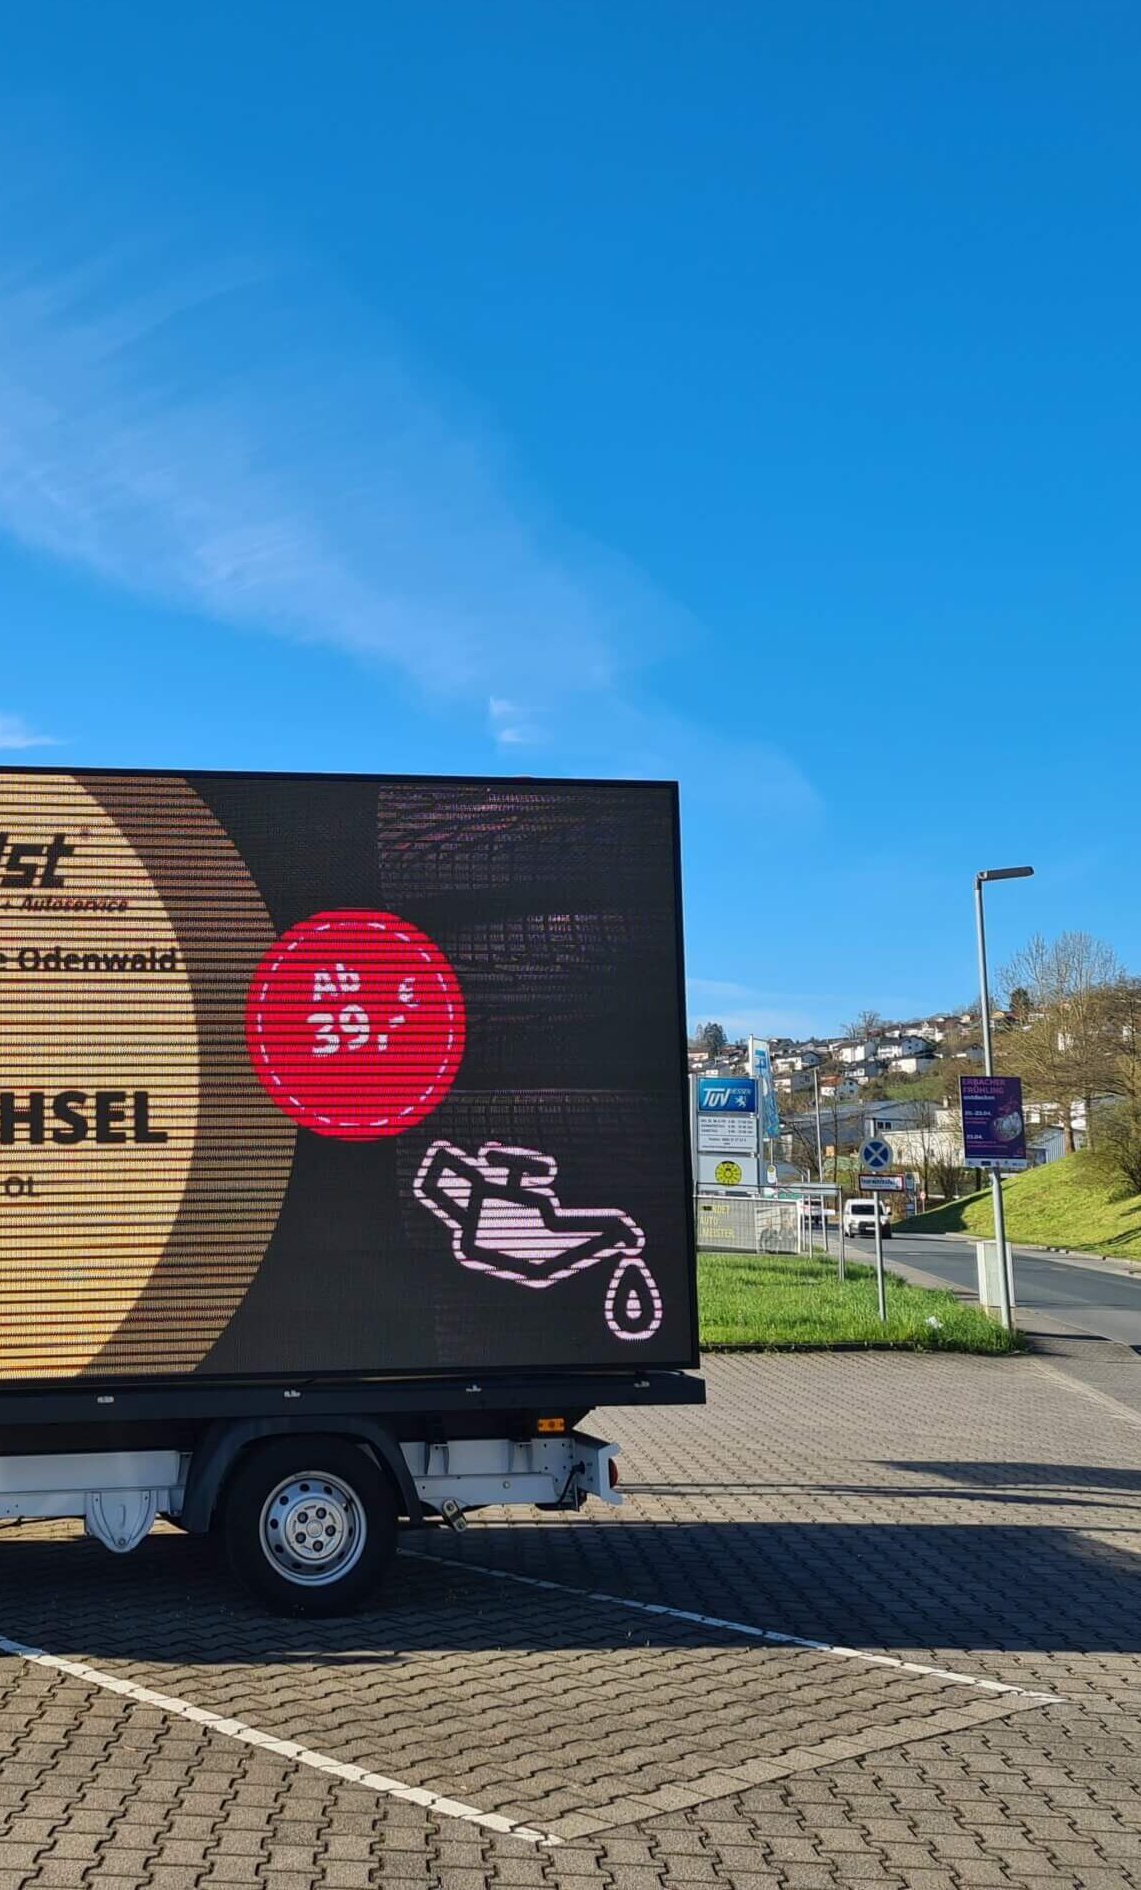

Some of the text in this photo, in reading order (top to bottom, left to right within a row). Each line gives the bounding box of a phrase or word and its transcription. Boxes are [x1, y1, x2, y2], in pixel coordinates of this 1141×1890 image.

[21, 894, 129, 912] Autoservice
[18, 946, 178, 972] Odenwald
[702, 1088, 731, 1107] TÜV
